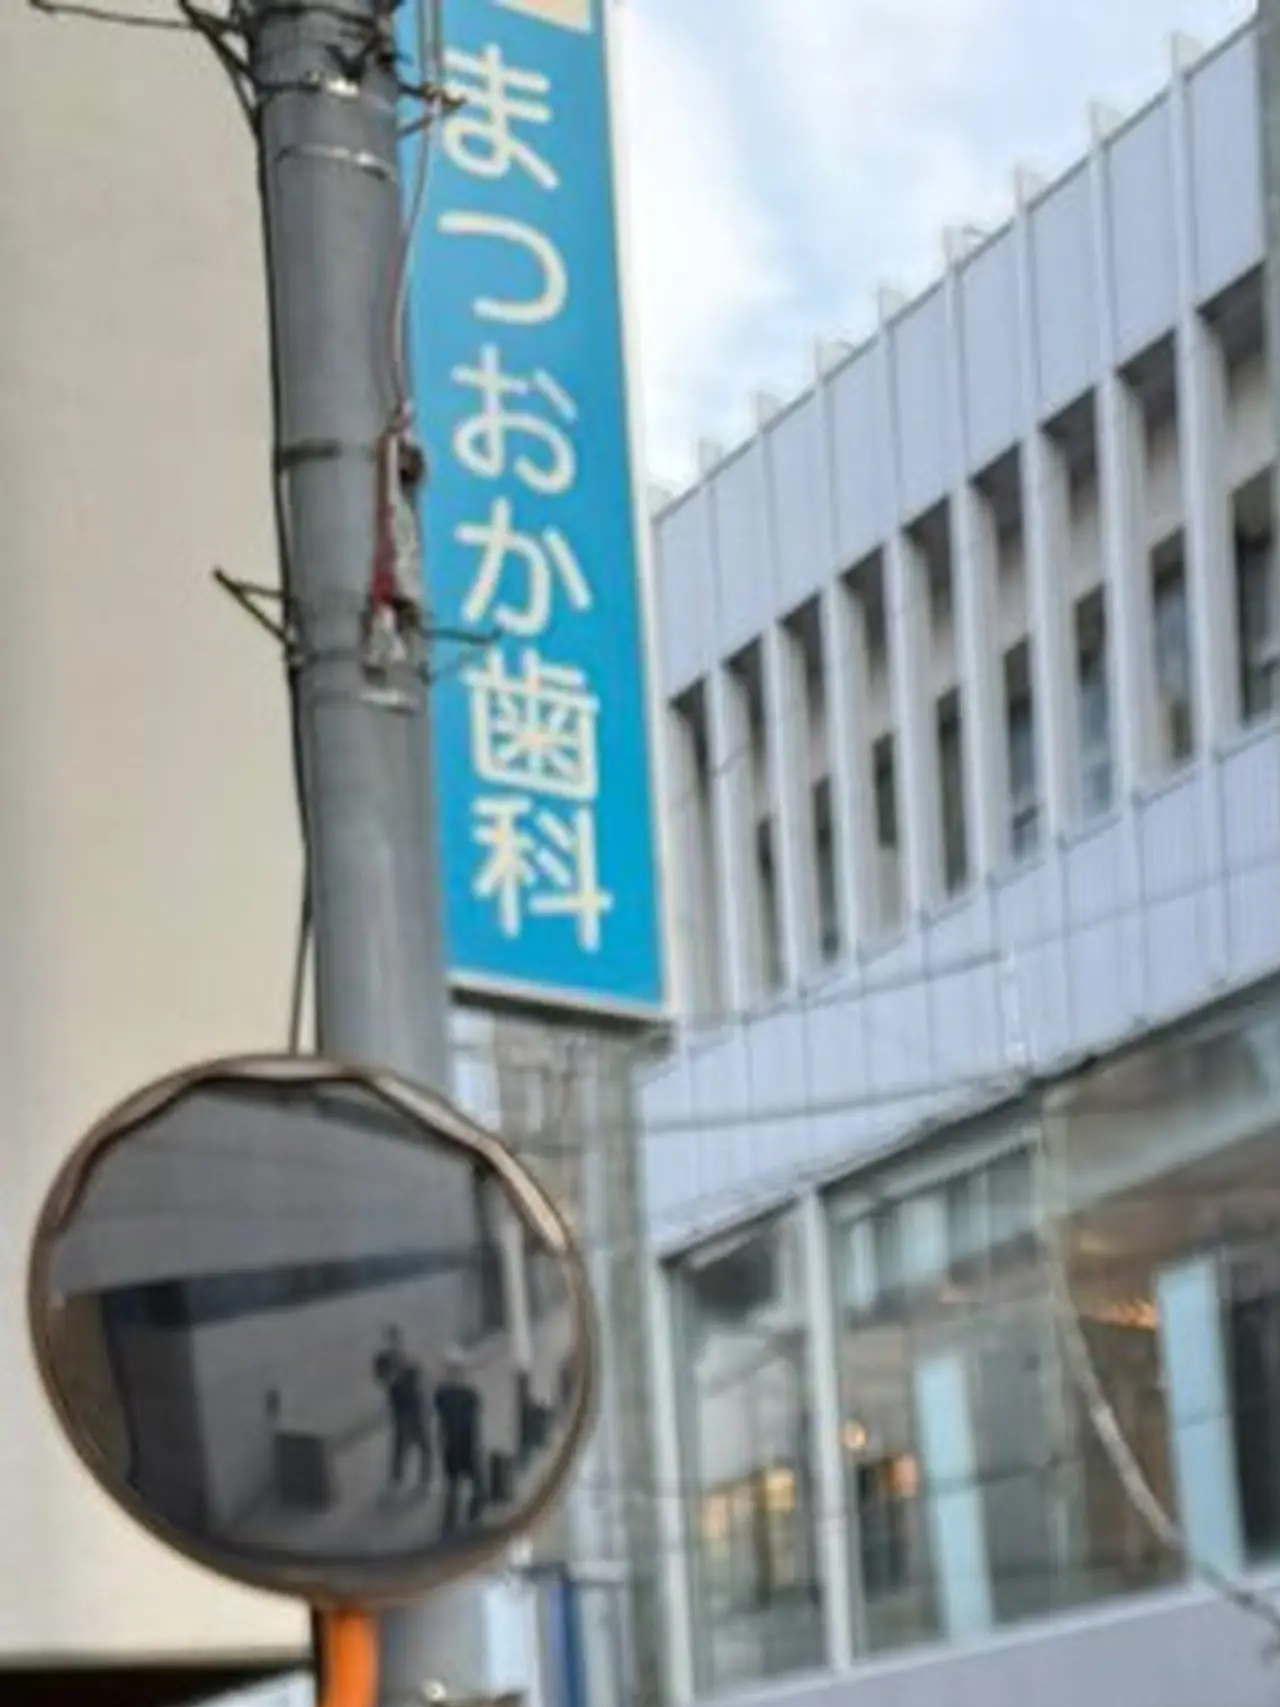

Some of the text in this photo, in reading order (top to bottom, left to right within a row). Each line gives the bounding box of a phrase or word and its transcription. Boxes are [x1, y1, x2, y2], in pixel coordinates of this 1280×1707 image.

[436, 42, 614, 956] まつおか歯科
